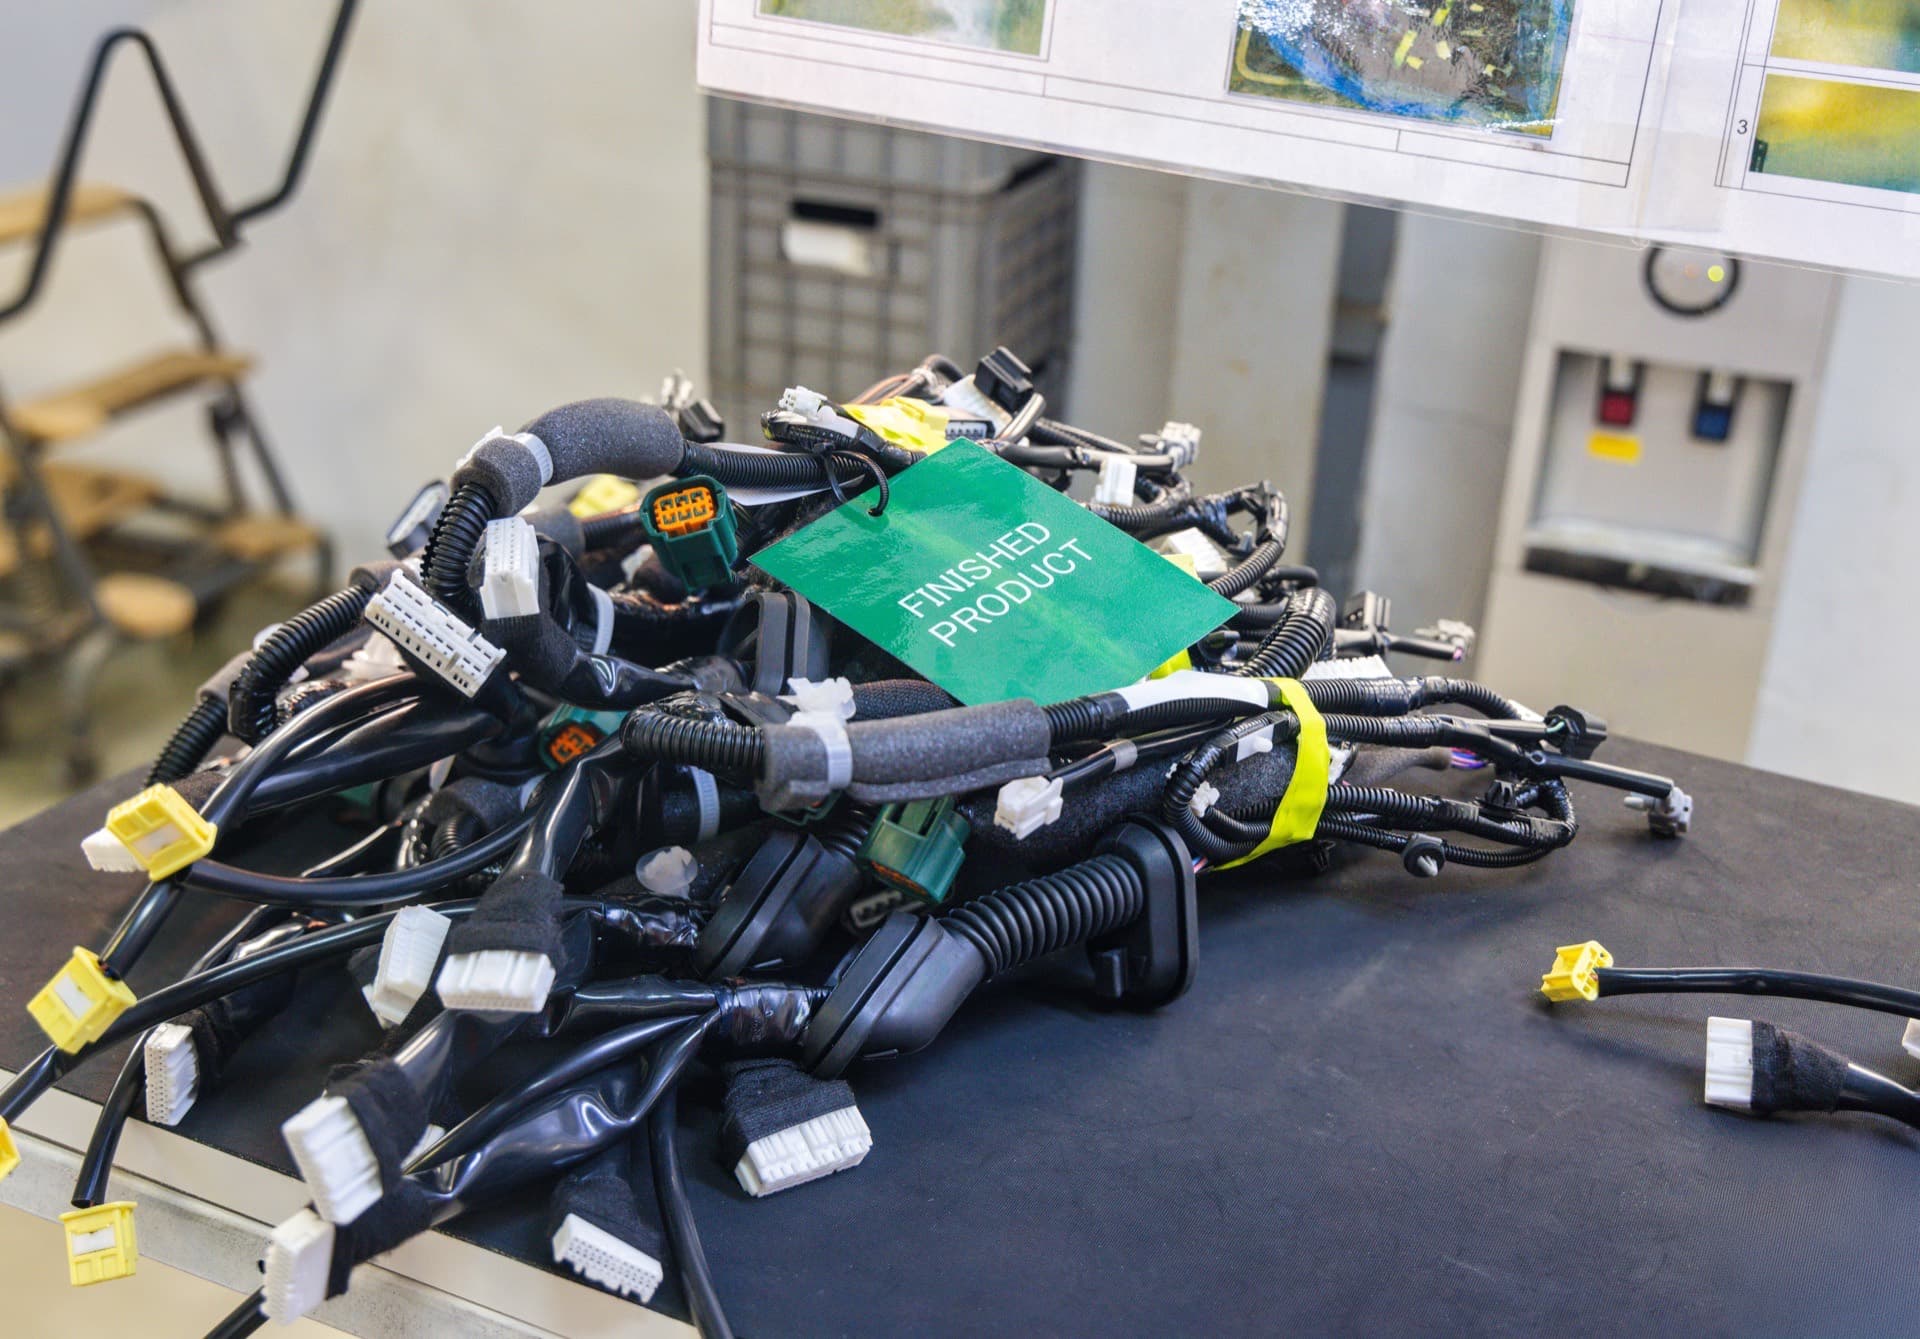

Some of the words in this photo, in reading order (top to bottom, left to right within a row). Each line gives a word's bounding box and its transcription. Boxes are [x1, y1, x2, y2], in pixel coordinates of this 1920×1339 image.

[1736, 119, 1748, 135] 3
[897, 521, 1051, 619] FINISHED
[928, 537, 1092, 648] PRODUCT
